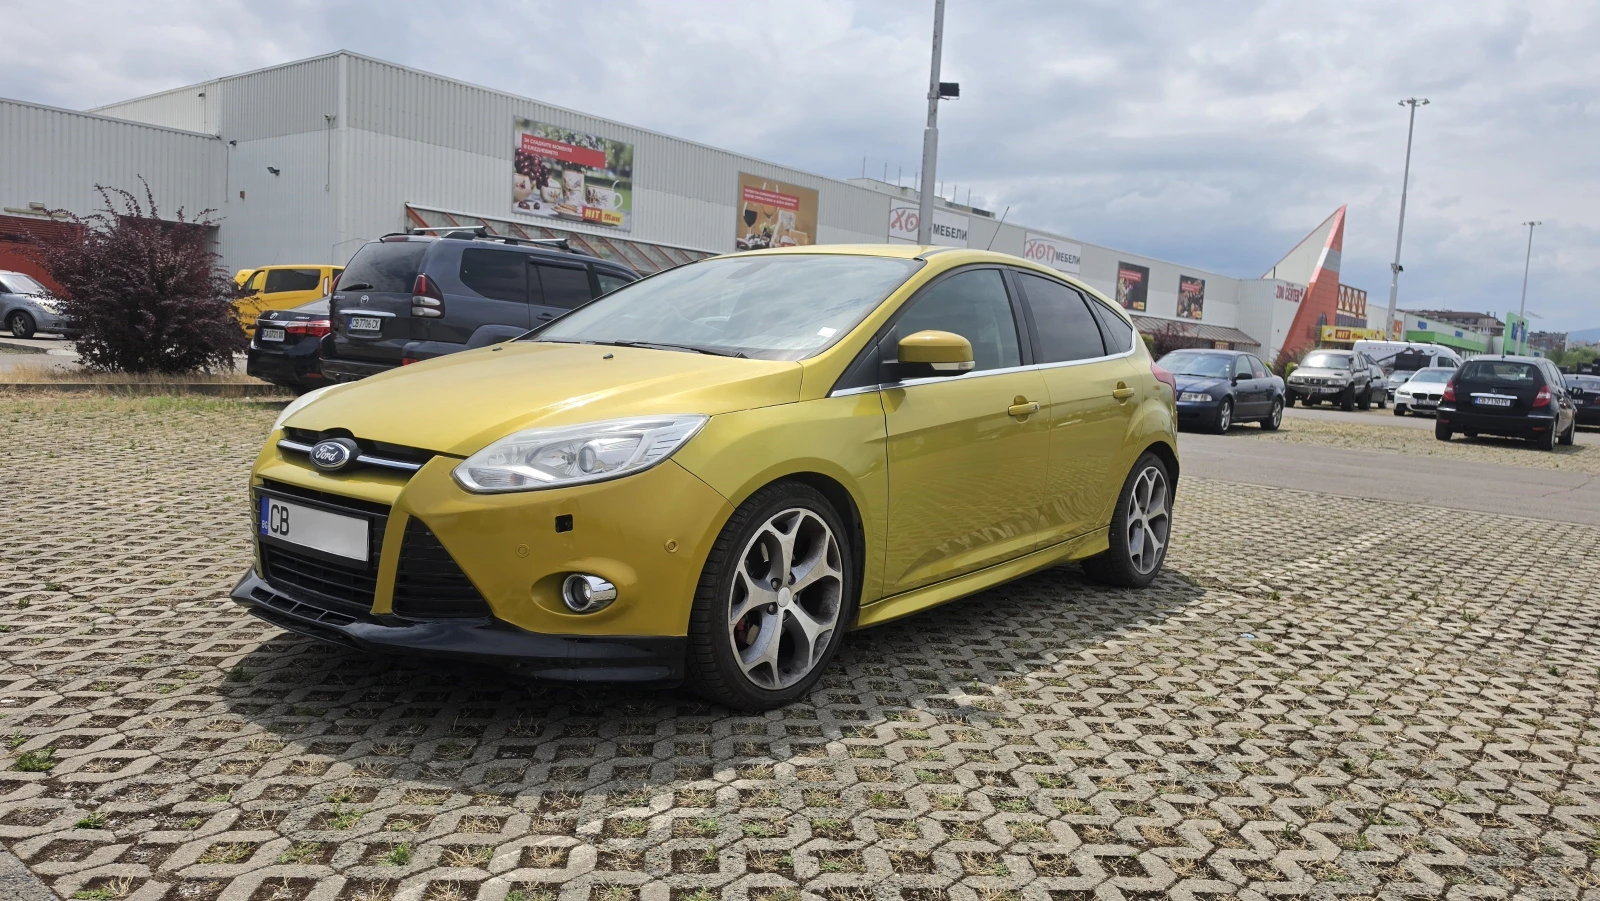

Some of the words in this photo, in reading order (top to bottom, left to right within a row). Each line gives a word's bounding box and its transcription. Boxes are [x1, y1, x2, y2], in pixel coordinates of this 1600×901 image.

[585, 209, 600, 219] HIT
[891, 209, 919, 233] ХО
[933, 223, 967, 241] МЕБЕЛИ
[1055, 251, 1081, 265] МЕБЕЛИ
[1336, 331, 1350, 339] HIT
[316, 444, 339, 462] Ford
[270, 503, 290, 536] CB
